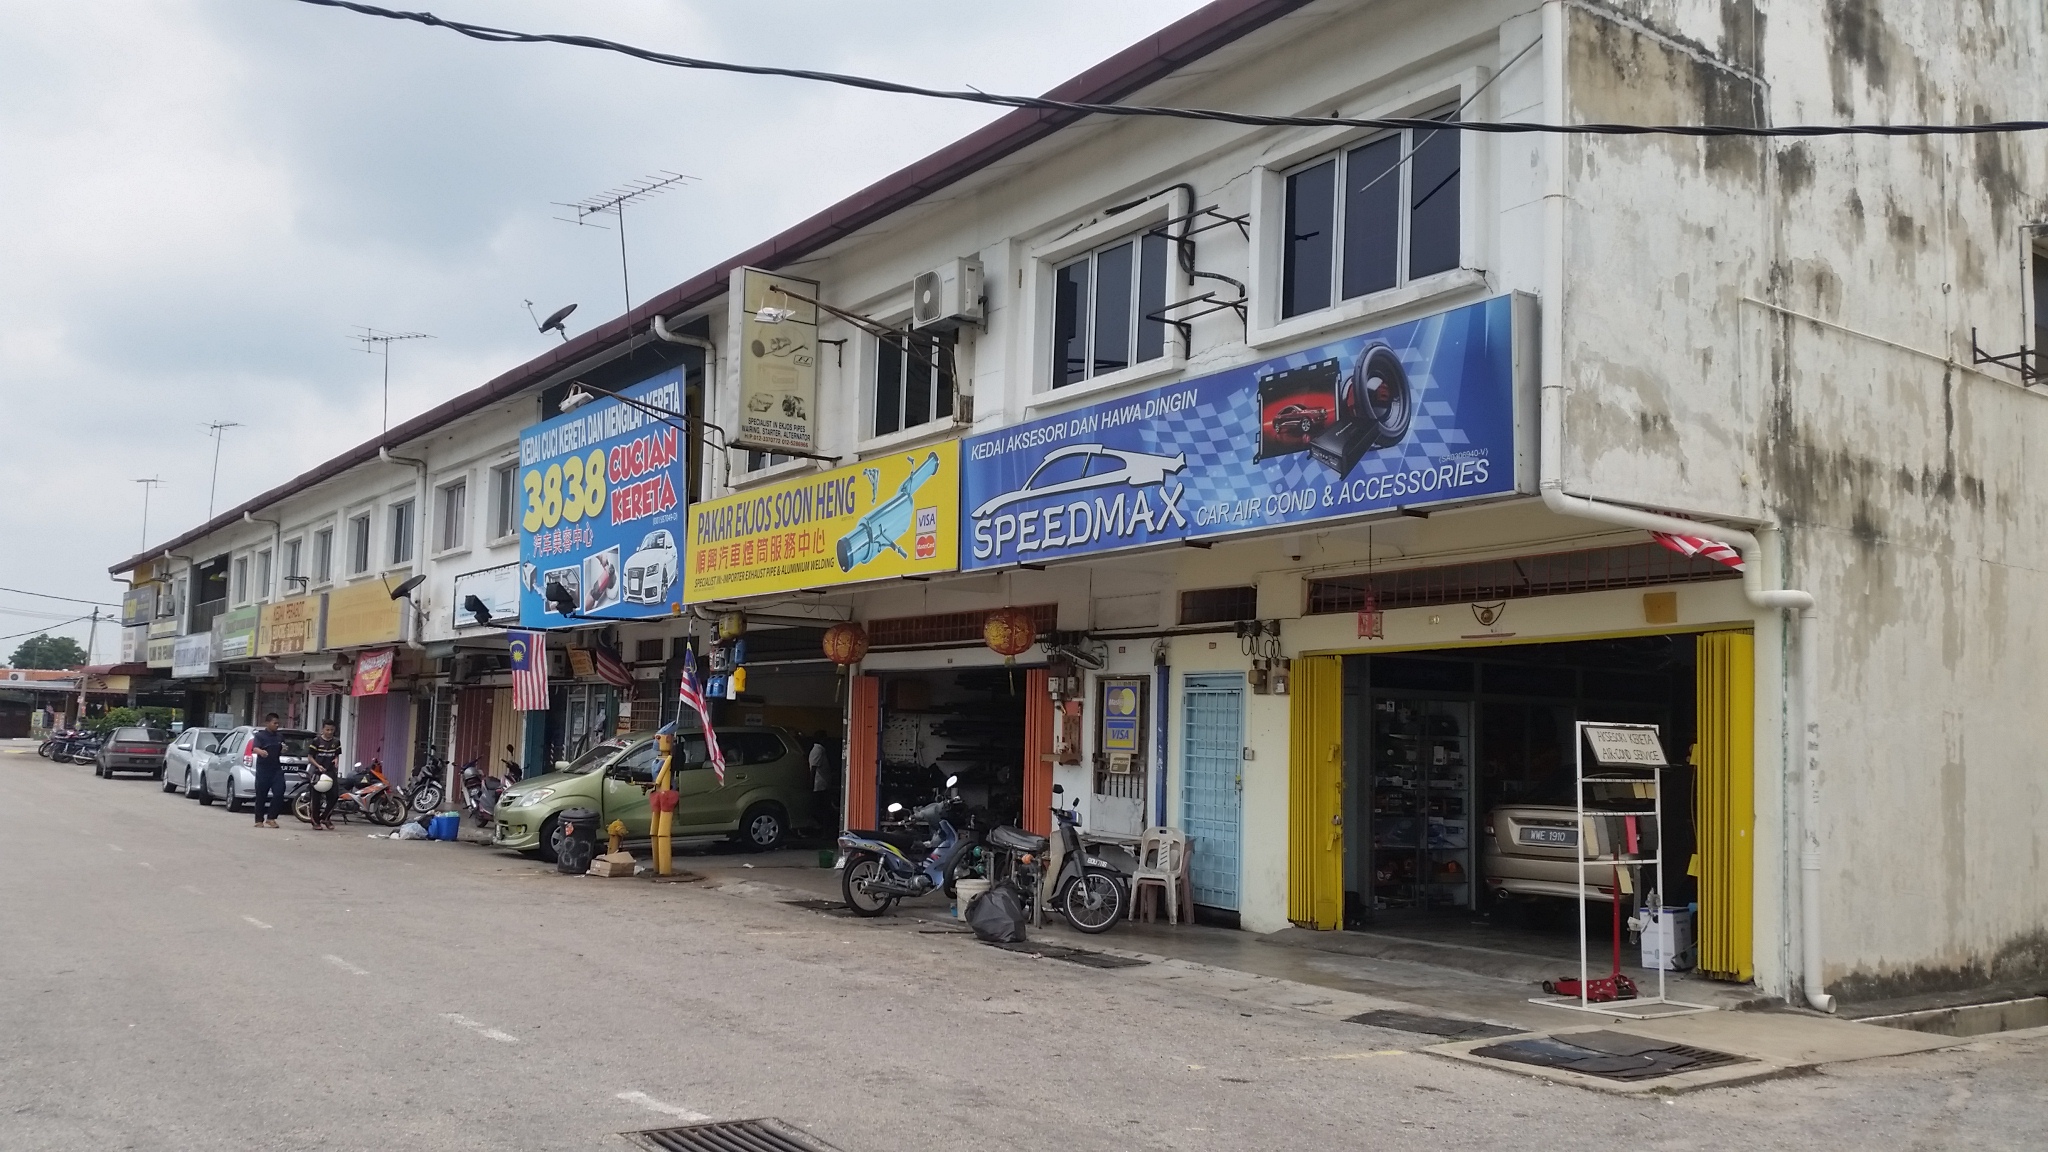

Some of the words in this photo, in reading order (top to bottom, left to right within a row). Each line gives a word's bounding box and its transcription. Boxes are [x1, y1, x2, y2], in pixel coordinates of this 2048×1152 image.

[521, 433, 541, 466] KEDAI
[542, 429, 557, 461] CUCI
[559, 417, 587, 454] KERETA
[587, 410, 604, 445] DAN
[604, 395, 644, 439] MENGILAP
[646, 382, 680, 424] KERETA
[970, 440, 1005, 462] KEDAI
[1006, 422, 1068, 454] AKSESORI
[1069, 414, 1099, 437] DAN
[1100, 405, 1142, 431] HAWA
[1145, 388, 1198, 418] DINGIN
[608, 426, 678, 485] CUCIAN
[523, 448, 607, 533] 3838
[611, 470, 678, 526] KERETA
[697, 505, 733, 545] PAKAR
[735, 495, 772, 537] EKJOS
[774, 486, 814, 528] SOON
[816, 475, 856, 520] HENG
[1196, 501, 1231, 526] CAR
[1232, 496, 1262, 523] AIR
[1265, 487, 1317, 516] COND
[1321, 483, 1336, 507] &
[1339, 458, 1490, 504] ACCESSORIES
[533, 521, 594, 558] 汽车美容中心
[918, 513, 936, 527] VISA
[971, 482, 1187, 560] SPEEDMAX
[745, 567, 766, 581] EXHAUST
[766, 566, 777, 577] PIPE
[1111, 729, 1129, 740] VISA
[1596, 731, 1628, 743] AKSESORI
[1627, 733, 1654, 746] KERETA
[1633, 749, 1660, 761] SERVICE
[1530, 830, 1546, 840] WWE
[1549, 831, 1566, 842] 1910
